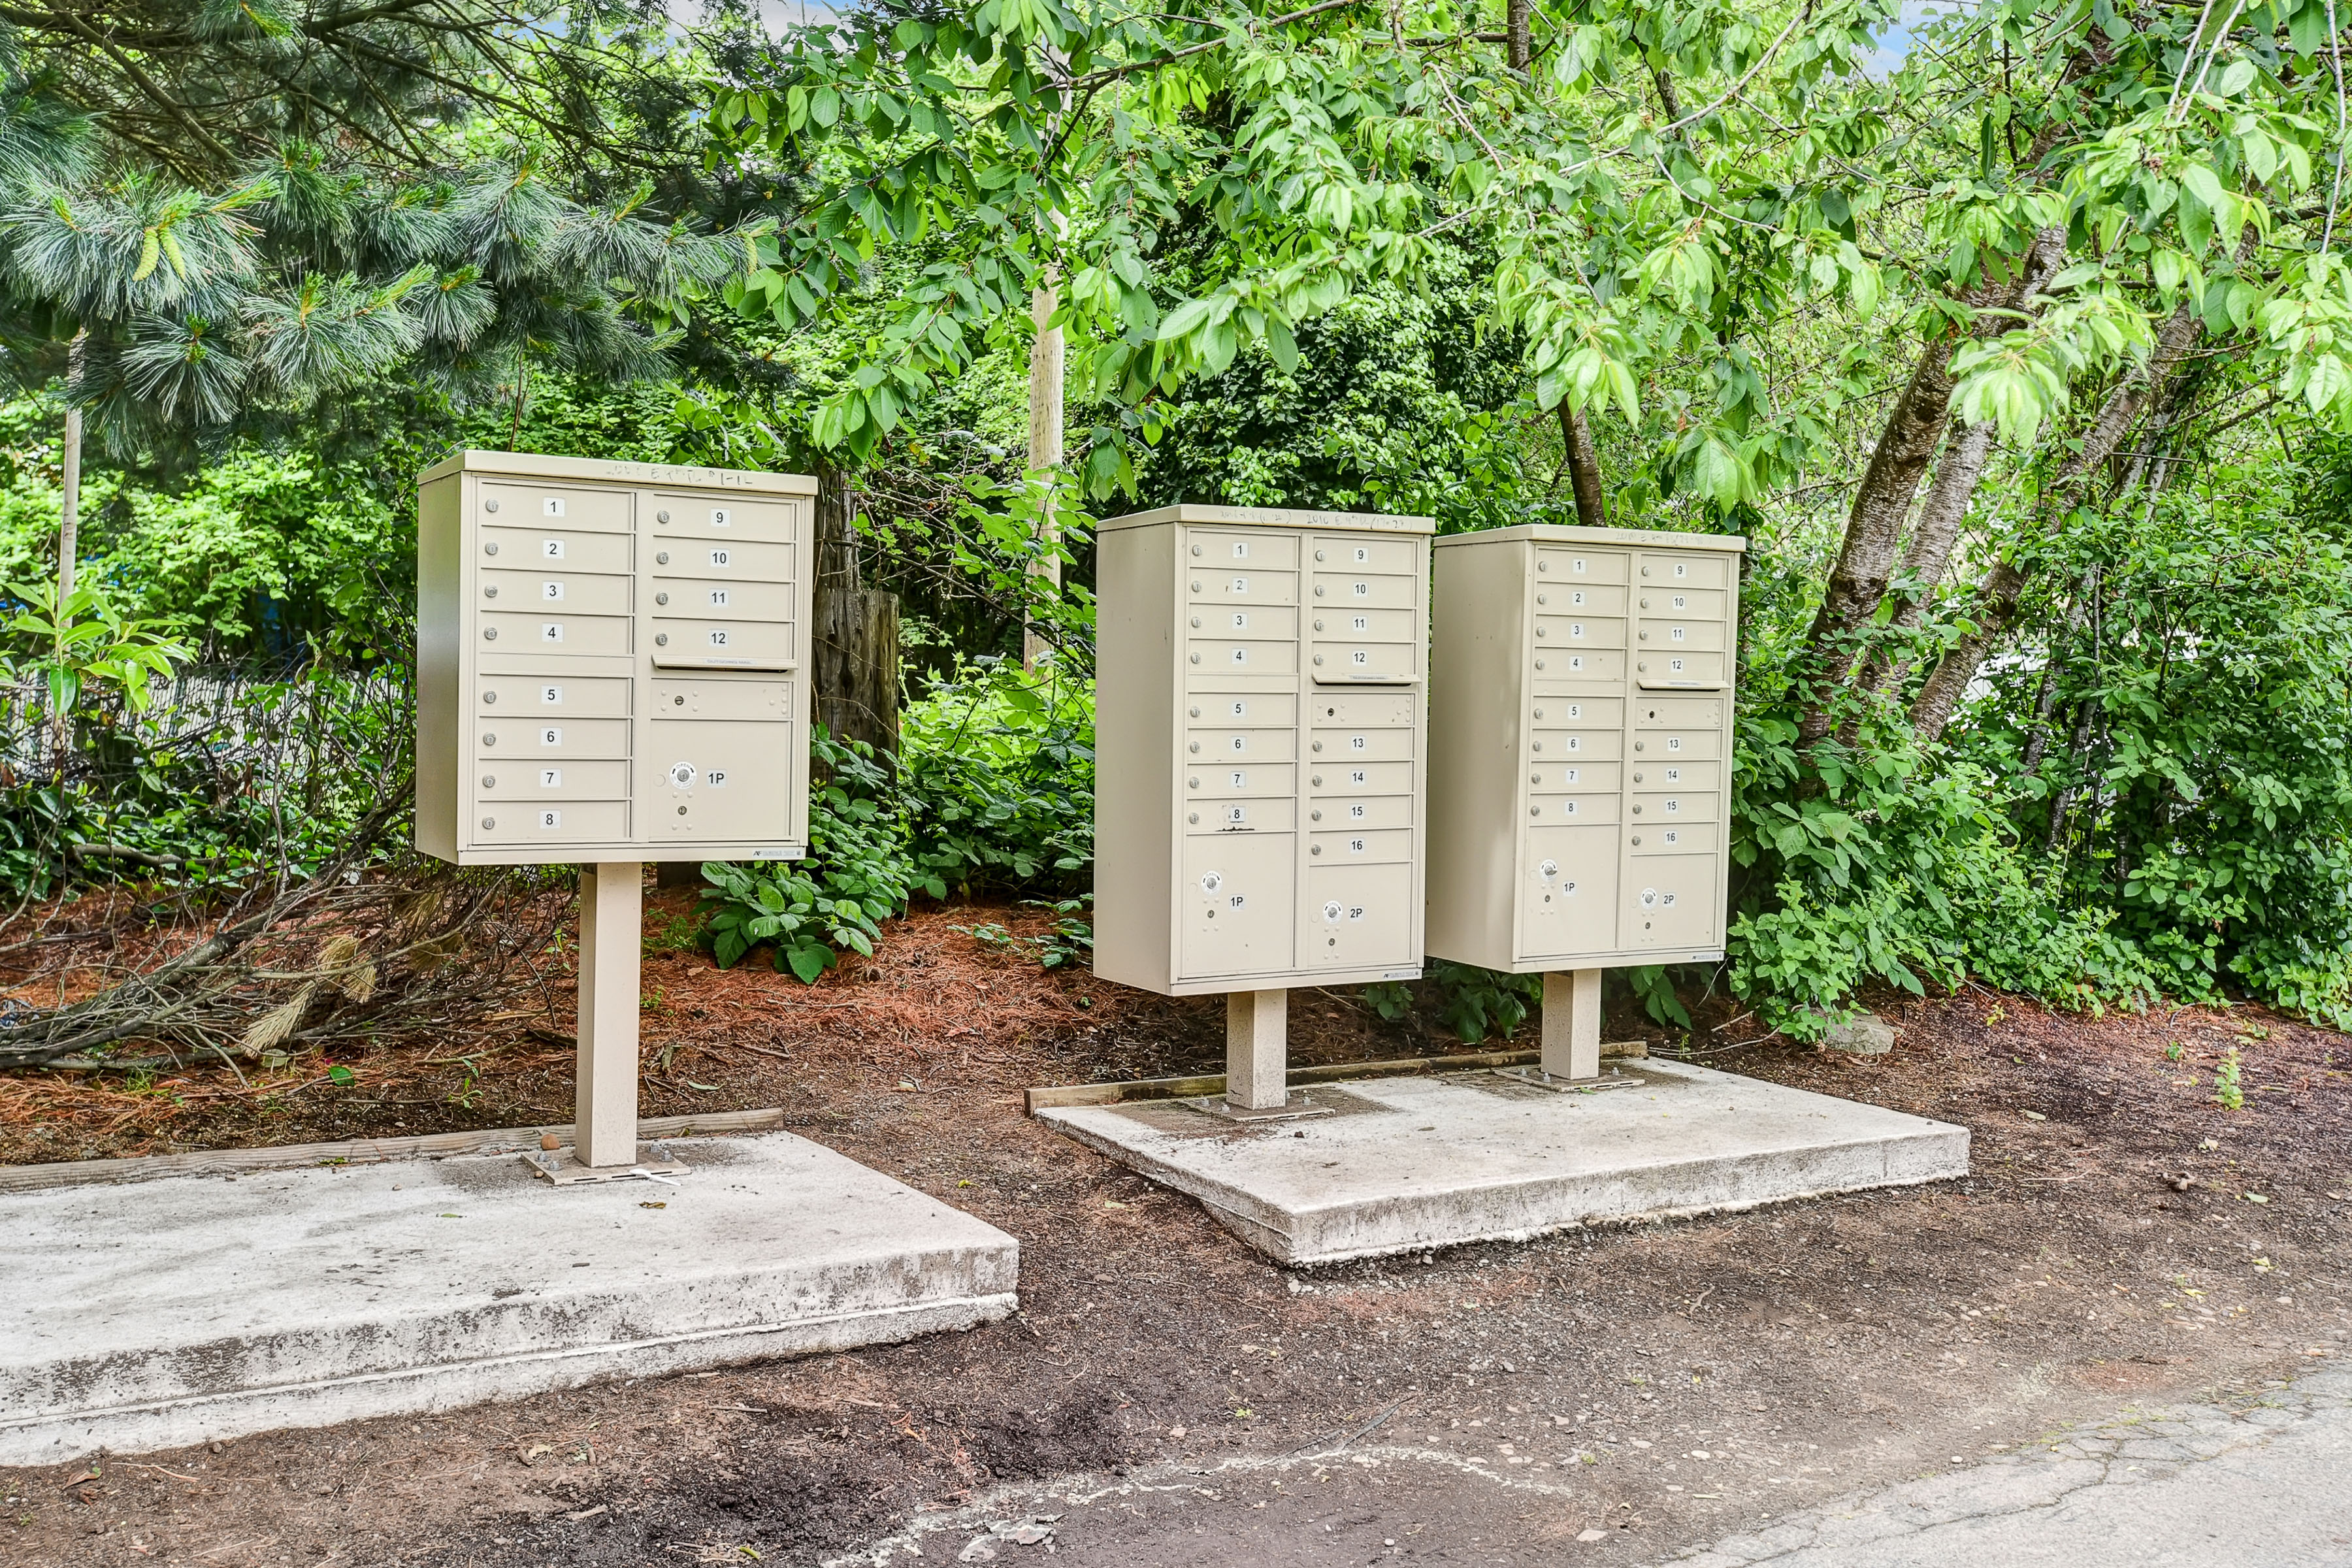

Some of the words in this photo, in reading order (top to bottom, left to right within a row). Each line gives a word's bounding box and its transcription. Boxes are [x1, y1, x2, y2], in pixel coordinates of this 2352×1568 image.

[549, 500, 557, 514] 1
[715, 511, 724, 524] 9
[548, 542, 558, 555] 2
[1237, 544, 1243, 555] 1
[711, 551, 727, 564] 10
[1357, 549, 1364, 561] 9
[1576, 560, 1582, 571] 1
[1676, 564, 1683, 576] 9
[548, 584, 557, 597] 3
[1236, 579, 1243, 591] 2
[1354, 583, 1367, 595] 10
[711, 591, 725, 604] 11
[1575, 593, 1581, 603] 2
[1674, 596, 1684, 608] 10
[1235, 614, 1243, 626] 3
[1354, 617, 1365, 629] 11
[547, 626, 557, 639] 4
[1574, 625, 1580, 636] 3
[1673, 629, 1682, 638] 11
[710, 632, 727, 645] 12
[1235, 650, 1243, 661] 4
[1353, 652, 1365, 663] 12
[1573, 657, 1579, 668] 4
[1671, 659, 1682, 670] 12
[547, 688, 556, 701] 5
[1235, 703, 1242, 714] 5
[1571, 706, 1578, 717] 5
[546, 730, 555, 743] 6
[1234, 738, 1242, 749] 6
[1352, 737, 1364, 749] 13
[1570, 738, 1576, 749] 6
[1669, 738, 1679, 749] 13
[546, 772, 555, 785] 7
[708, 772, 725, 785] 1P
[1233, 773, 1241, 785] 7
[1352, 772, 1364, 783] 14
[1569, 770, 1575, 781] 7
[1667, 770, 1678, 779] 14
[1567, 802, 1574, 813] 8
[1667, 800, 1677, 811] 15
[1233, 808, 1241, 820] 8
[1351, 806, 1364, 817] 15
[545, 813, 554, 826] 8
[1666, 832, 1676, 842] 16
[1350, 840, 1364, 851] 16
[1563, 882, 1575, 892] 1P
[1230, 896, 1244, 907] 1P
[1663, 894, 1674, 905] 2P
[1349, 907, 1364, 919] 2P
